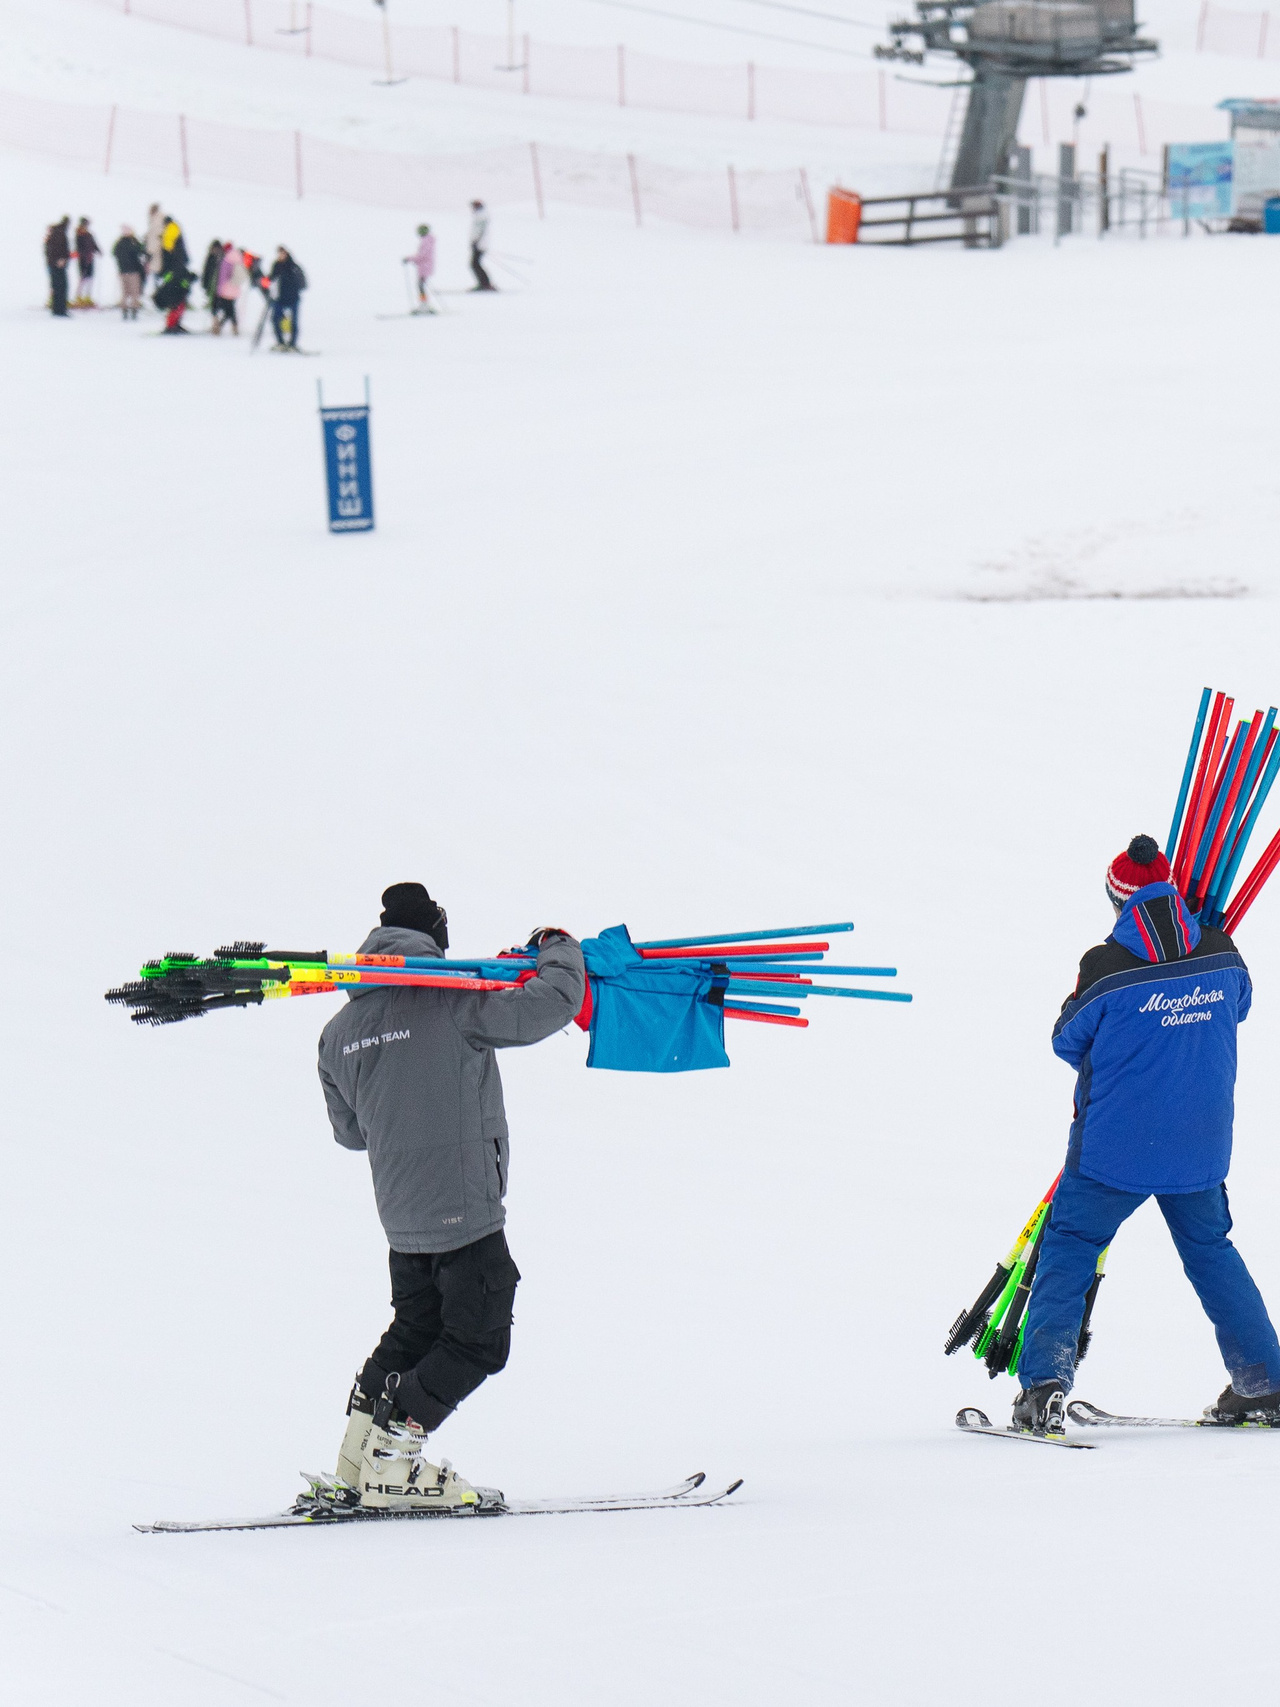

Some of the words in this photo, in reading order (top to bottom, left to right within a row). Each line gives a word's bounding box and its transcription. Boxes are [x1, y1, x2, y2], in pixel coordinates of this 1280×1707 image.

[334, 424, 362, 517] ФИНИШ
[1139, 986, 1225, 1013] Московская
[1161, 1008, 1212, 1027] область
[381, 1029, 410, 1043] TEAM
[365, 1482, 445, 1497] HEAD
